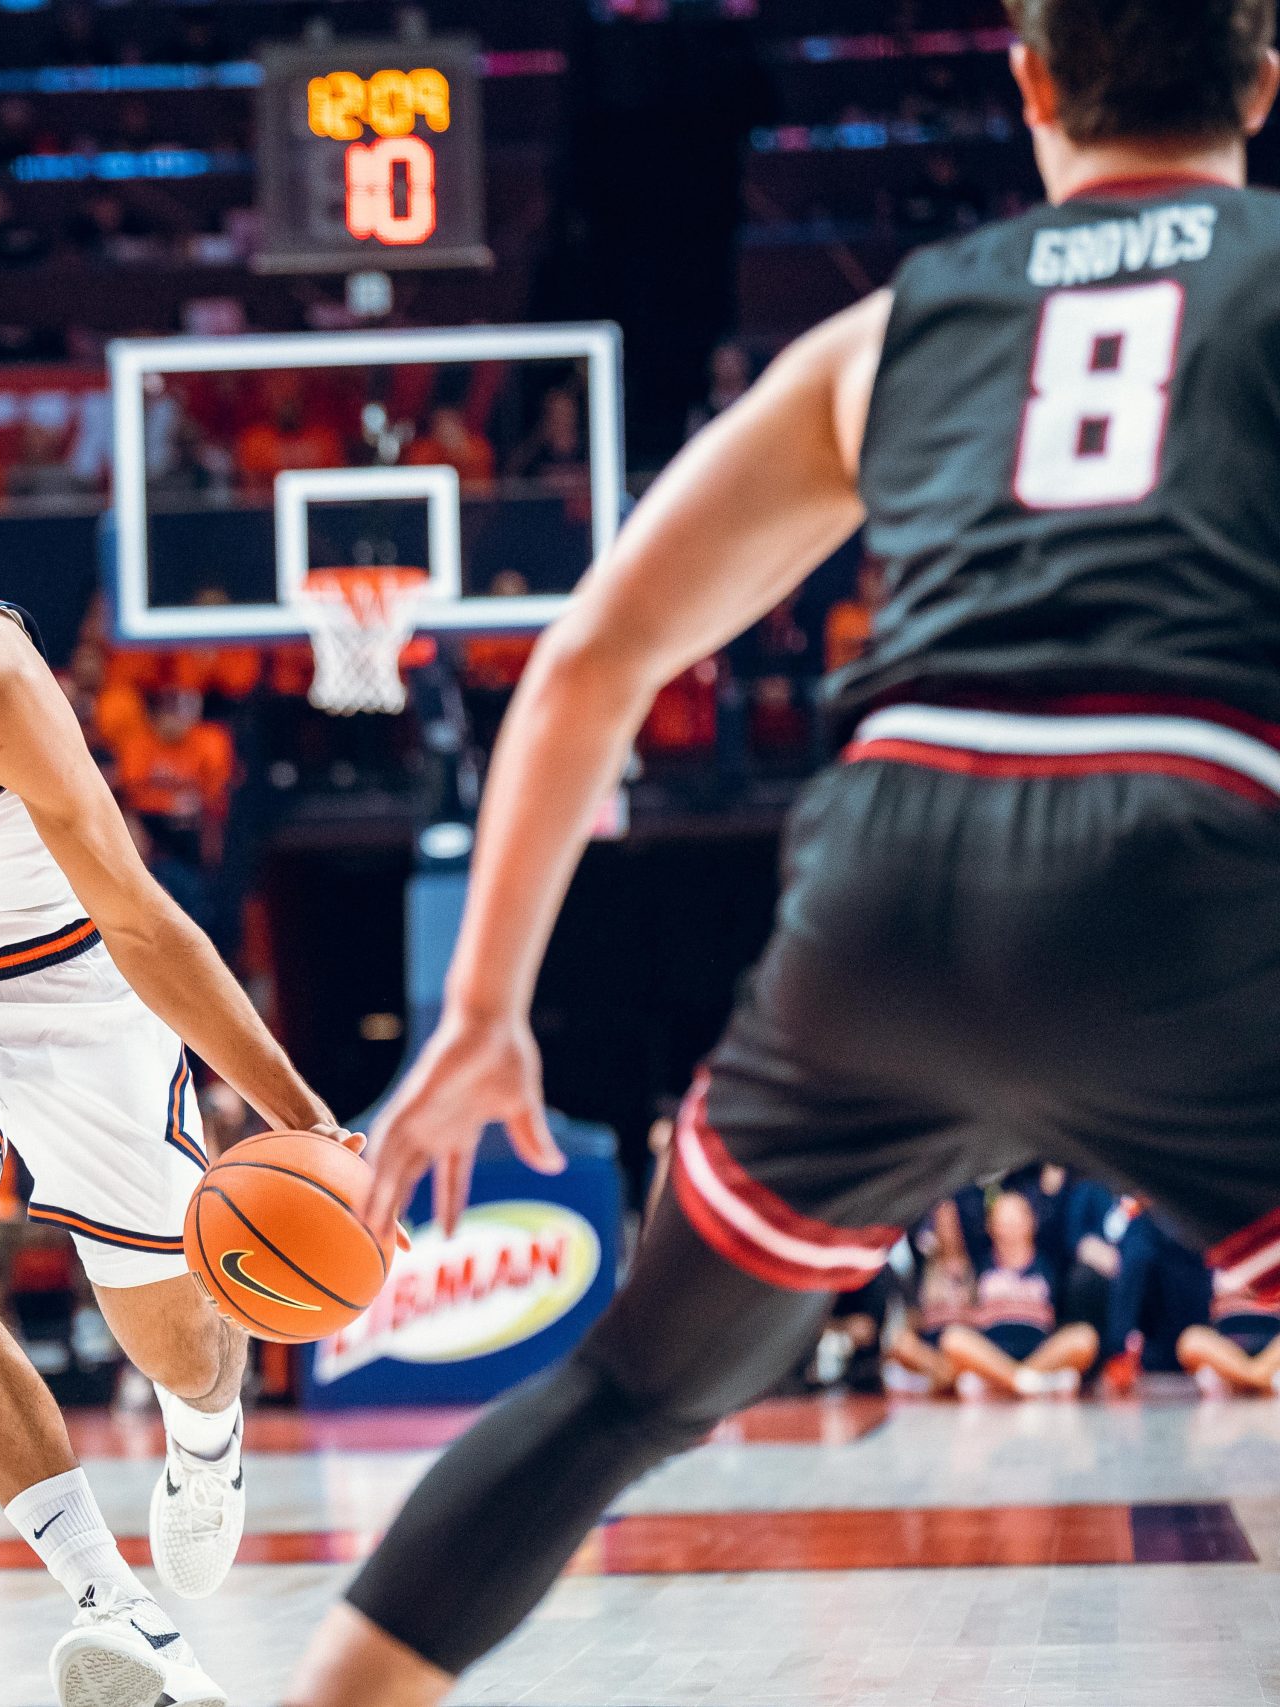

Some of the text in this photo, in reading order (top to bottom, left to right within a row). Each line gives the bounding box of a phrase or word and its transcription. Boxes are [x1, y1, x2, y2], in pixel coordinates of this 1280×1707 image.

[344, 133, 437, 246] 10
[1026, 203, 1217, 287] GROVES
[1013, 278, 1187, 511] 8
